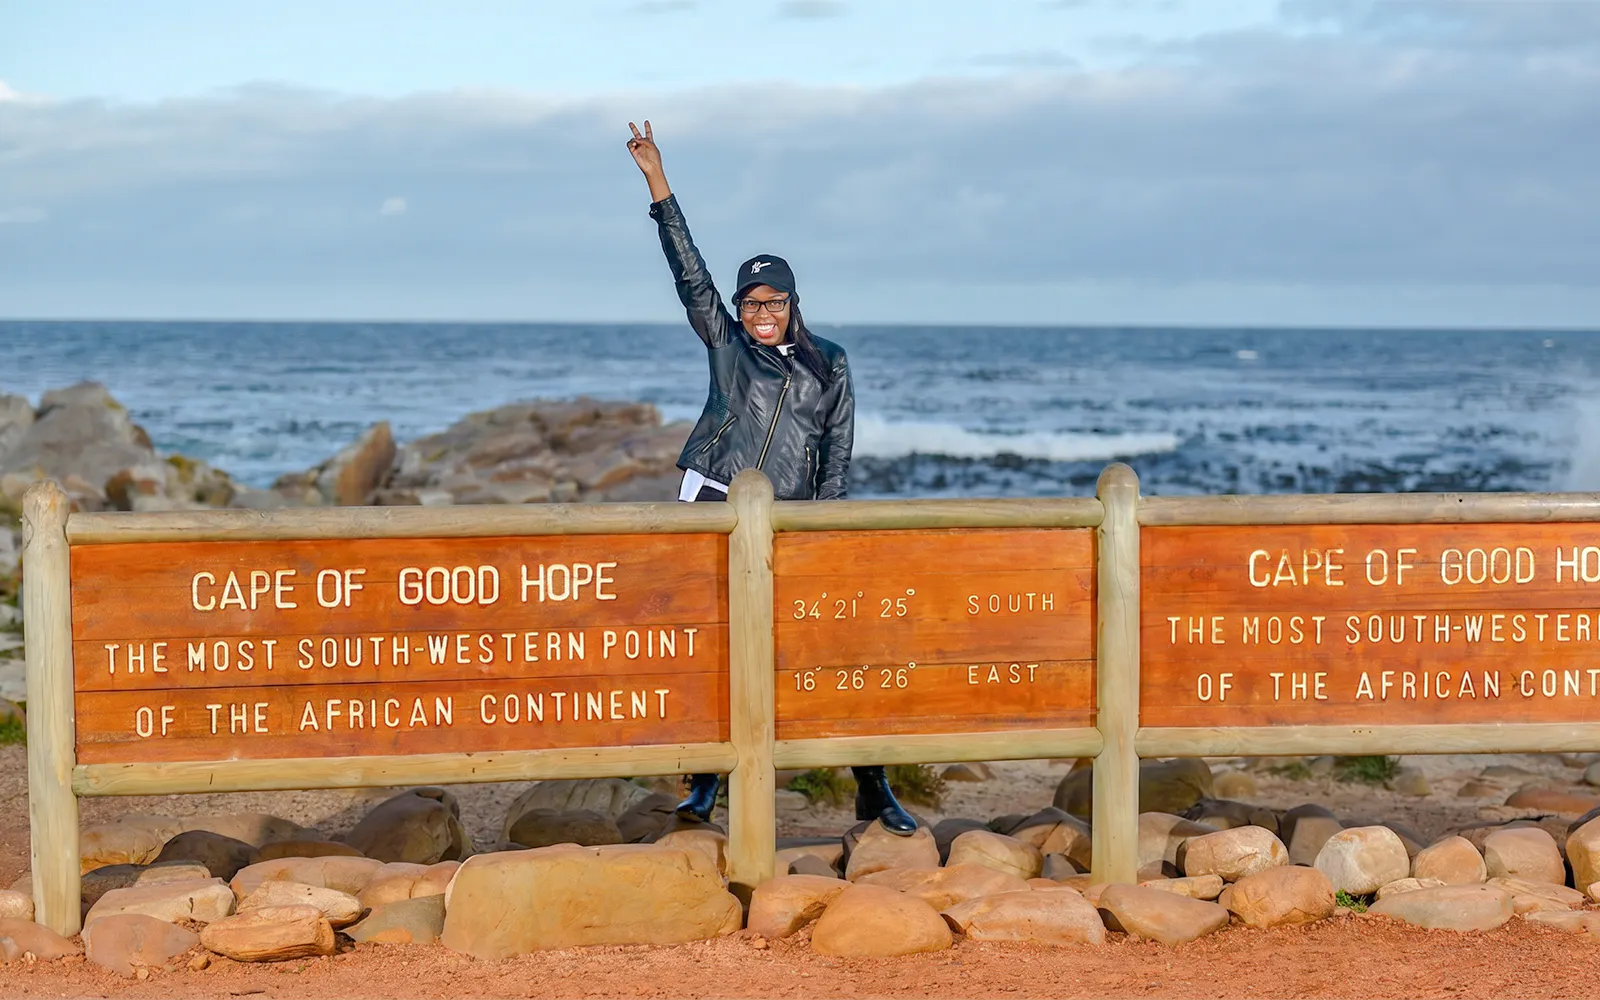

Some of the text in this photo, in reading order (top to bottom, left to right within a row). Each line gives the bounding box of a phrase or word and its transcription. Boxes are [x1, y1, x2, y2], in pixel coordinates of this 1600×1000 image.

[1248, 548, 1345, 587] CAPE
[1365, 548, 1418, 586] OF
[1440, 546, 1535, 586] GOOD
[192, 562, 617, 611] CAPE OF GOOD HOPE
[968, 592, 1054, 615] SOUTH
[1167, 613, 1600, 644] THE MOST SOUTH-WESTER
[104, 628, 698, 674] THE MOST SOUTH-WESTERN POINT
[968, 663, 1039, 684] EAST
[1197, 672, 1234, 701] OF
[1269, 672, 1328, 701] THE
[1355, 670, 1499, 700] AFRICAN
[136, 689, 670, 738] OF THE AFRICAN CONTINENT
